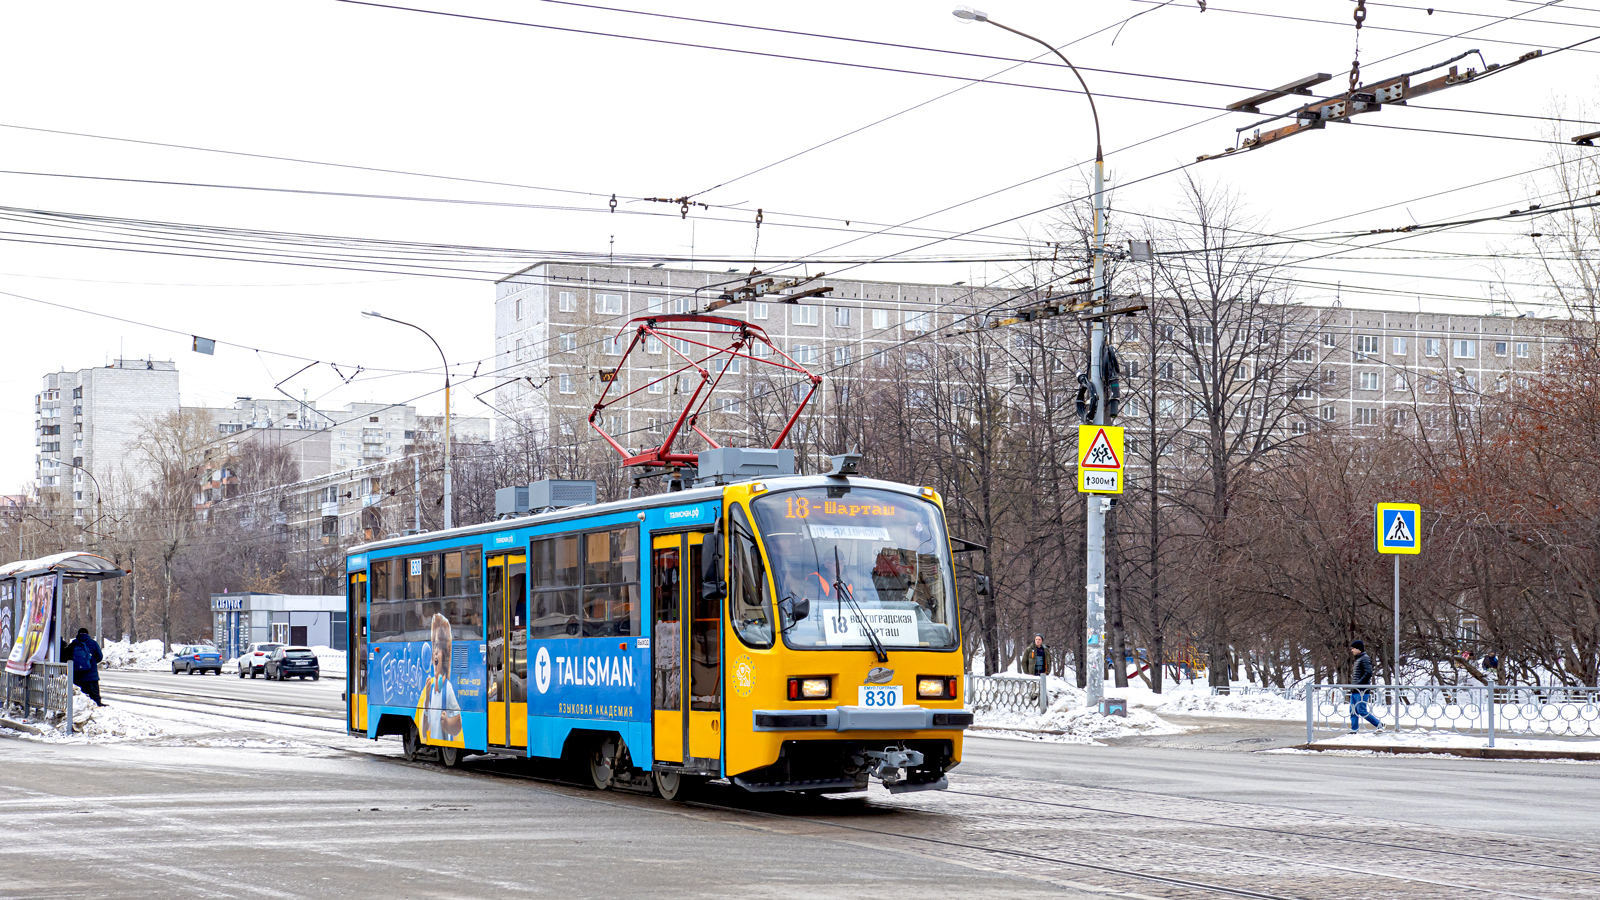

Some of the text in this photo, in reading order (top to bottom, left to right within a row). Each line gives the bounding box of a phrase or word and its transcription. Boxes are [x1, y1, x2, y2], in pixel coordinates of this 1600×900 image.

[1091, 477, 1110, 485] 300м
[785, 497, 809, 518] 18
[412, 560, 421, 574] 830
[831, 616, 848, 634] 18
[865, 690, 896, 706] 830
[559, 703, 633, 718] ЯЗЫКОВАЯ АКАДЕМИЯ
